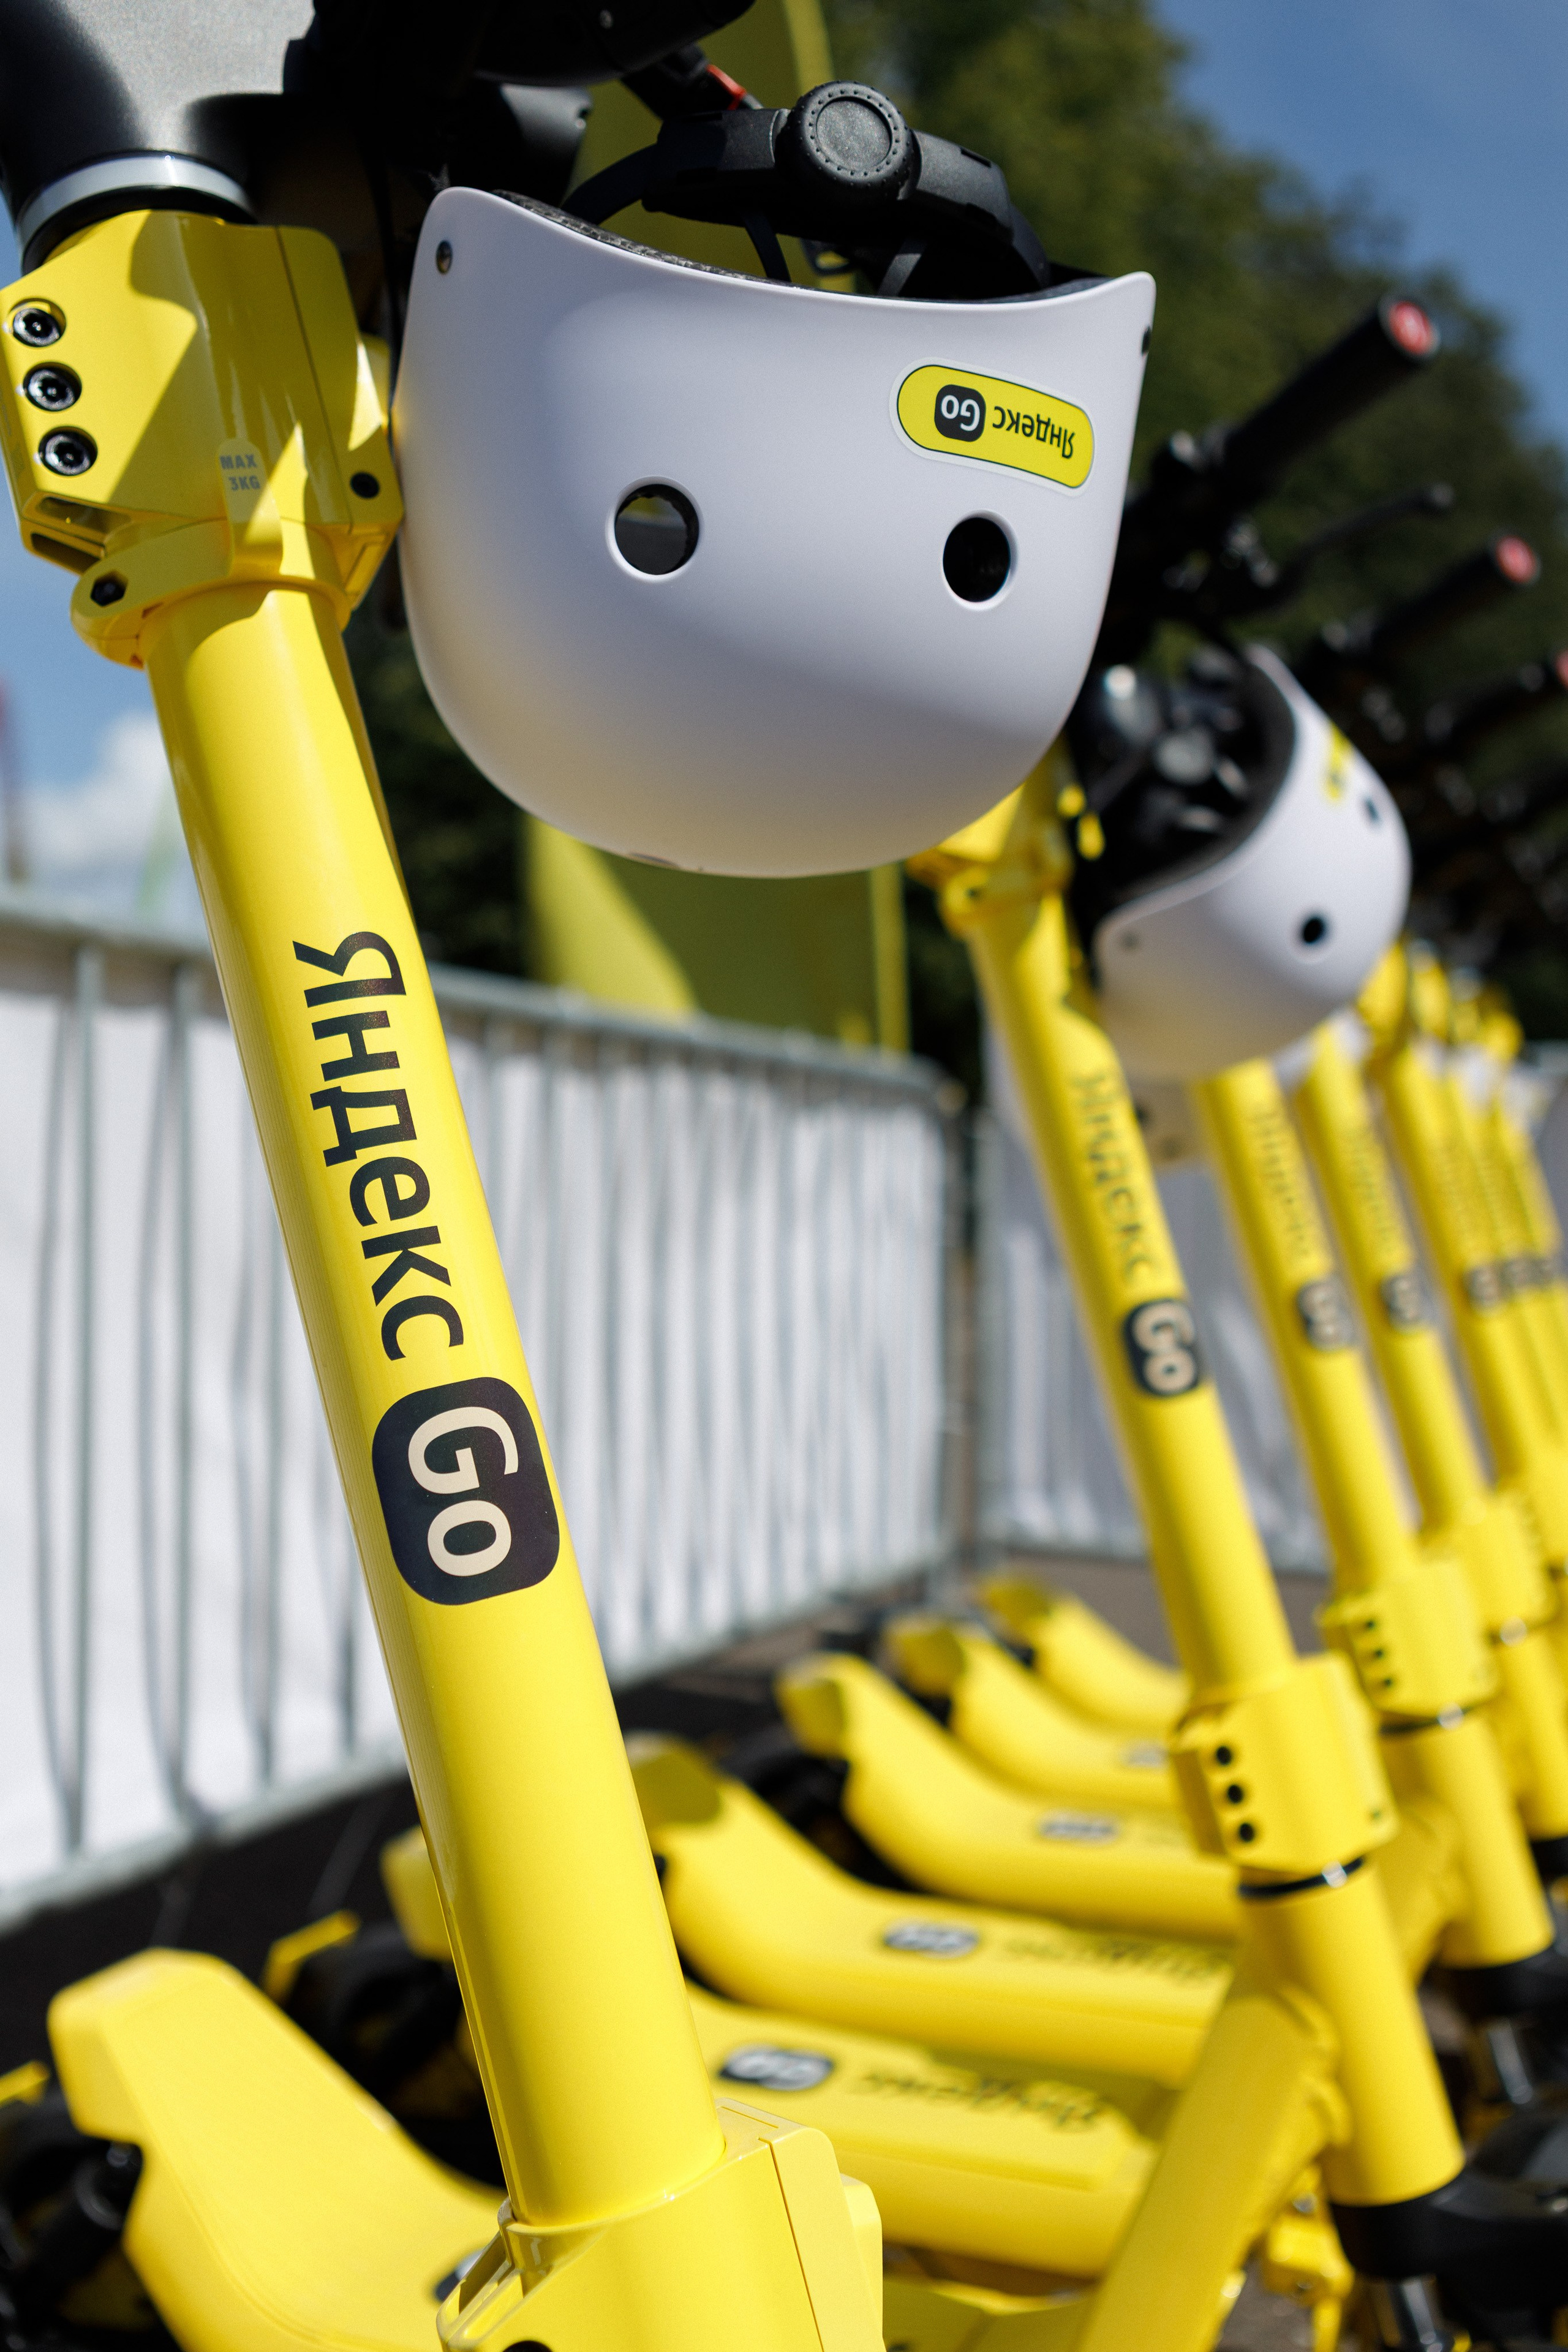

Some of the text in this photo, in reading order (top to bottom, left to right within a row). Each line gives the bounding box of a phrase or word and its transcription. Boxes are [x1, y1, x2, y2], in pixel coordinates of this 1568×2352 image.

[940, 394, 1076, 459] Яндекс Go
[219, 454, 257, 470] MAX
[228, 475, 261, 491] 3KG
[292, 930, 519, 1577] Яндекс Go
